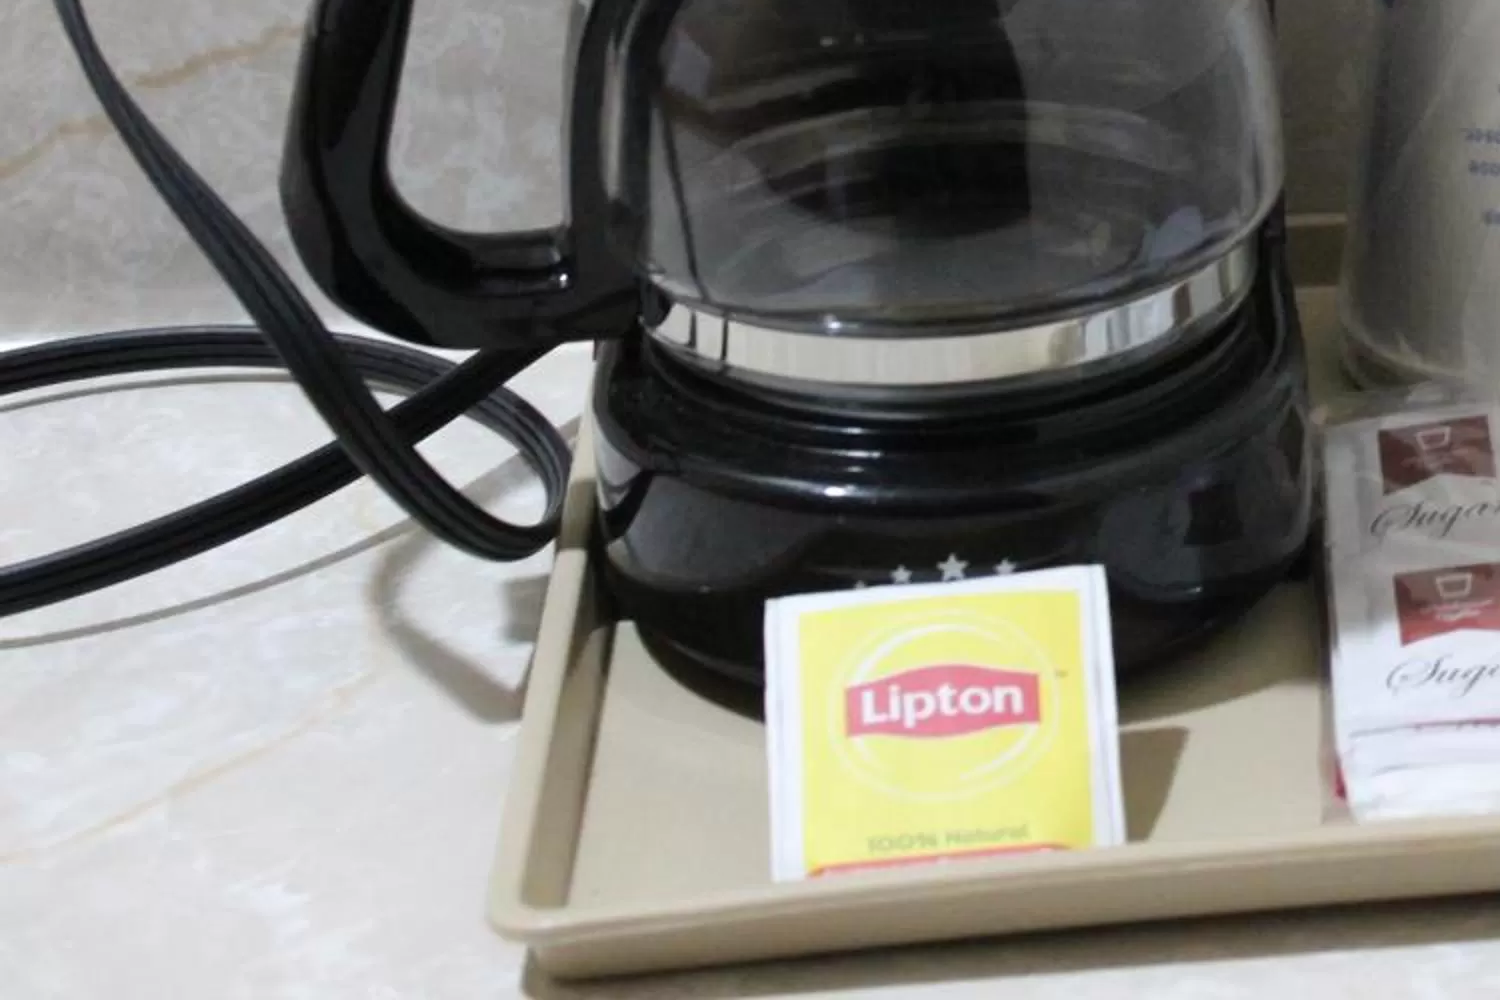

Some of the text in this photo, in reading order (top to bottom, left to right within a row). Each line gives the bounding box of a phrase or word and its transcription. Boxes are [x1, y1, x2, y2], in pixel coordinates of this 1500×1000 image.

[861, 682, 1025, 728] Lipton
[867, 823, 1030, 853] 100% Natural
